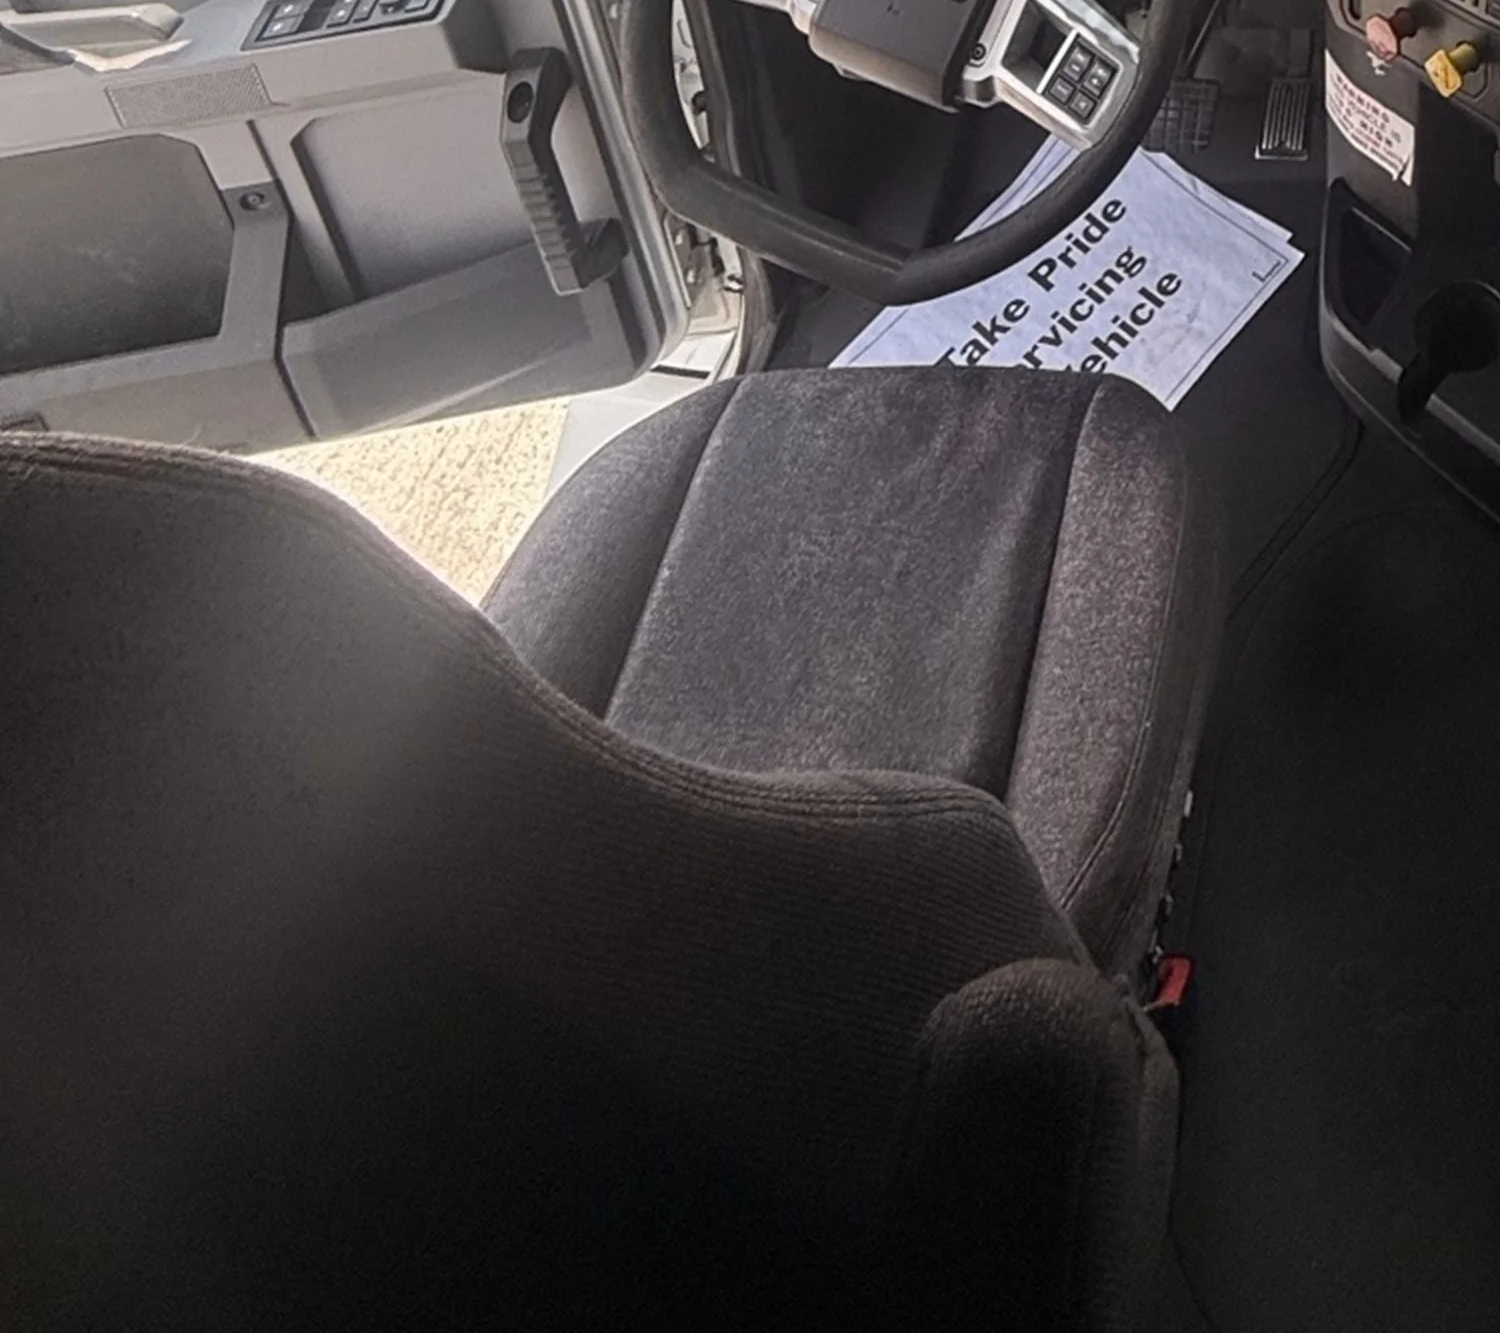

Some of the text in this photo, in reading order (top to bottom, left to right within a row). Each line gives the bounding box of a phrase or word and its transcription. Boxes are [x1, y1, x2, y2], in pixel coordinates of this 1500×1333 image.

[1027, 196, 1127, 292] Pride
[1015, 245, 1147, 369] rvicing
[1067, 270, 1183, 373] ehicle
